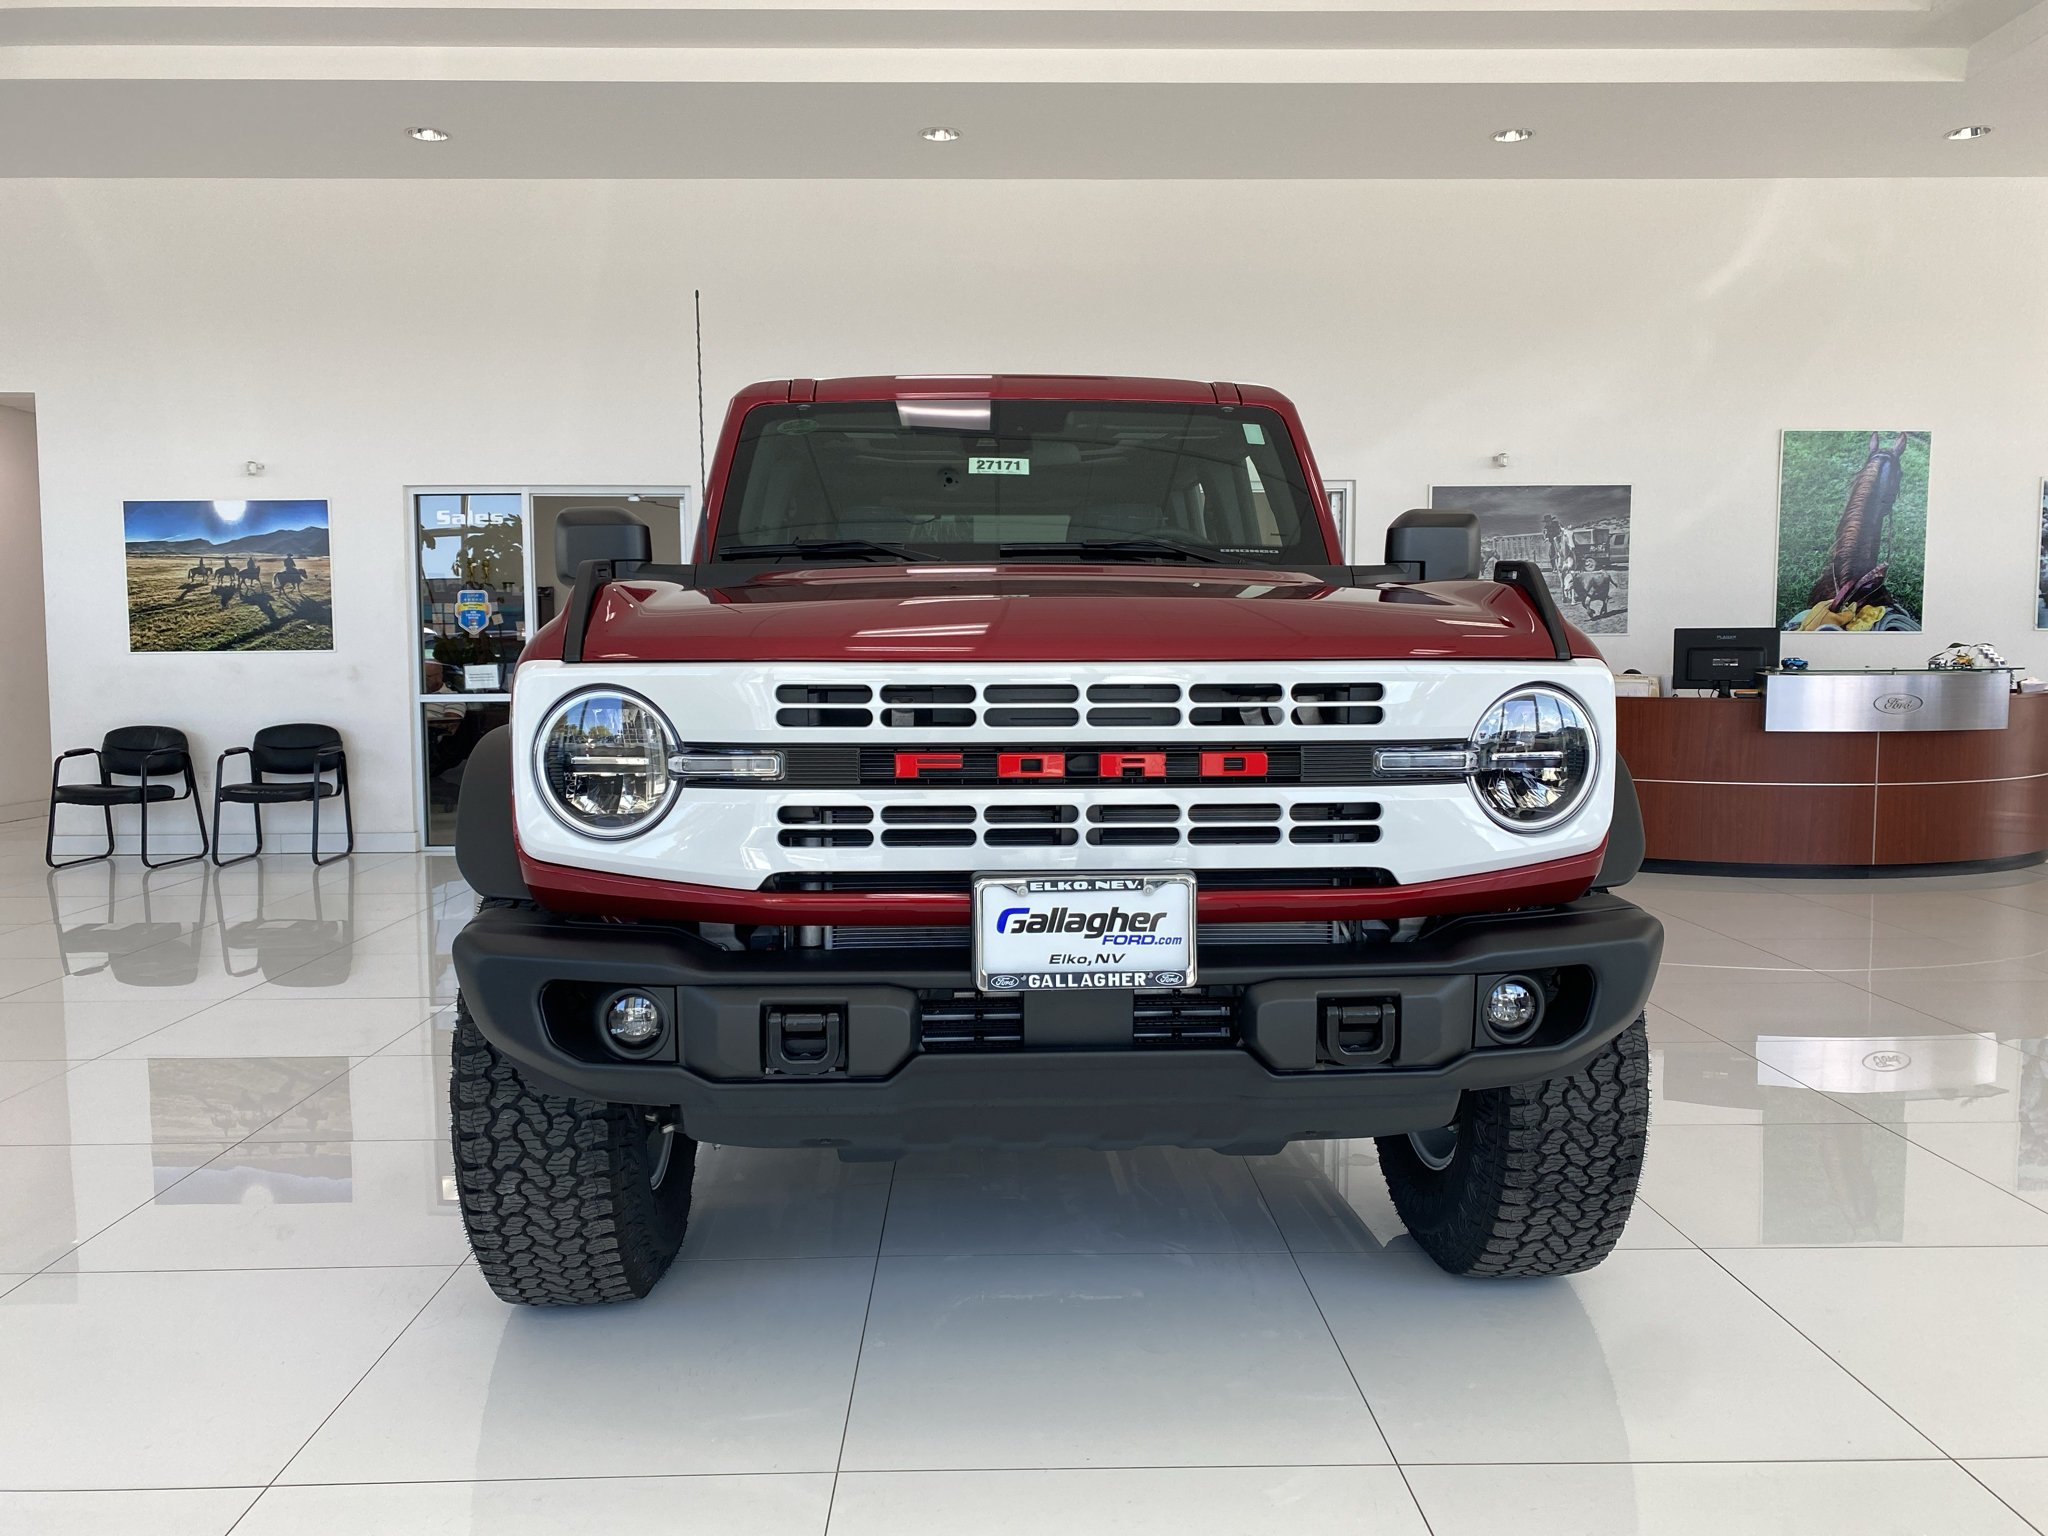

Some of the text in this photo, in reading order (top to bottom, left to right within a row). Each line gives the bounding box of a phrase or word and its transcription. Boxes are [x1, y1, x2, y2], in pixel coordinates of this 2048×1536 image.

[976, 460, 1020, 470] 27171
[436, 510, 504, 526] Sales
[894, 751, 1269, 778] FORD
[996, 907, 1167, 939] Gallagher
[1102, 935, 1182, 945] FORD.com
[1049, 953, 1126, 967] Elko, NV
[1028, 972, 1146, 989] GALLAGHER
